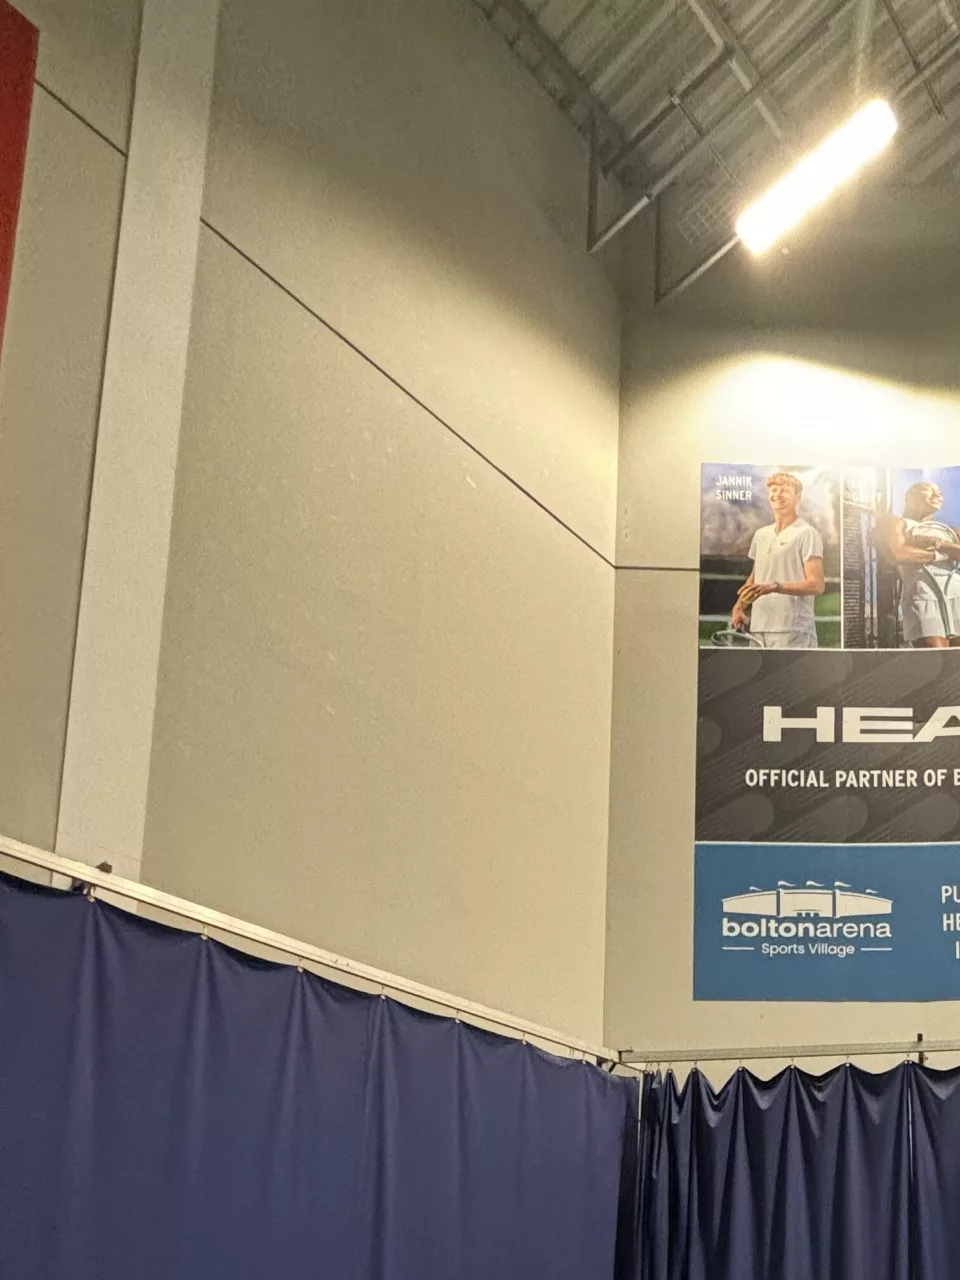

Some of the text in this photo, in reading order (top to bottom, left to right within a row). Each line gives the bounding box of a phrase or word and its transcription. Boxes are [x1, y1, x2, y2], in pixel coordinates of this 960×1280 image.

[716, 475, 752, 487] JANNIK
[716, 489, 752, 501] SINNER
[744, 768, 829, 788] OFFICIAL
[835, 769, 918, 788] PARTNER
[923, 769, 948, 787] OF
[722, 917, 893, 938] boltonarena
[761, 942, 855, 958] Sports Village
